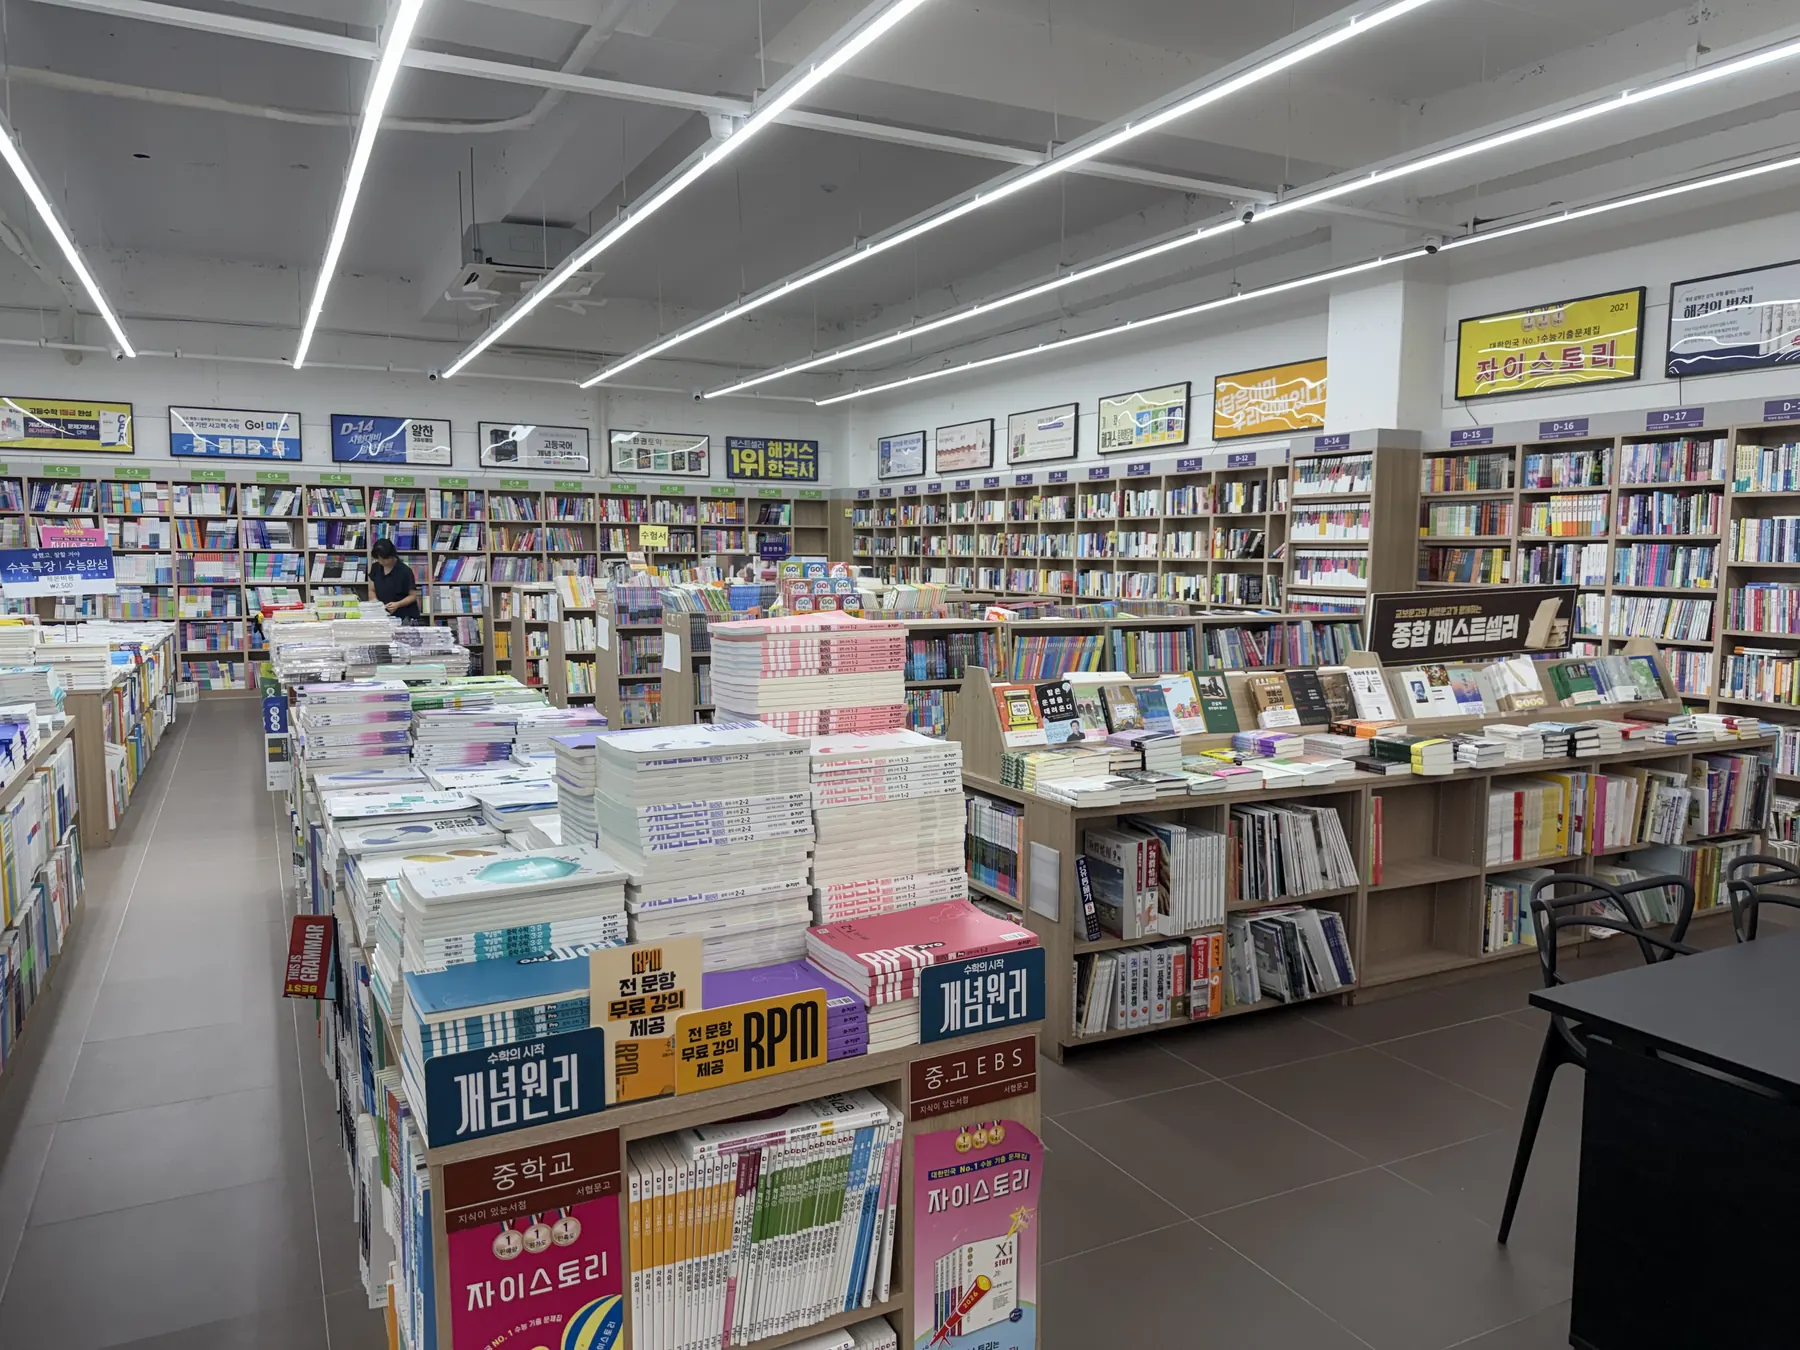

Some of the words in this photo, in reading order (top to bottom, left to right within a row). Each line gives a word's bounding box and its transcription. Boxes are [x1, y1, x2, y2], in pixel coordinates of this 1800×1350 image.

[1610, 303, 1628, 312] 2021
[1475, 339, 1616, 384] 자이스토리
[29, 408, 58, 416] 고등수학
[1663, 412, 1687, 421] D-17
[245, 420, 264, 430] Go!
[340, 420, 374, 435] D-14
[412, 424, 434, 437] 알찬
[1553, 422, 1574, 431] D-16
[1462, 430, 1481, 439] D-15
[544, 440, 572, 450] 고등국어
[730, 440, 764, 449] 베스트셀러
[768, 441, 814, 459] 해커스
[731, 449, 765, 477] 1위
[768, 459, 814, 478] 한국사
[641, 529, 666, 540] 수험서
[6, 560, 56, 574] 수능특강
[65, 559, 108, 571] 수능완성
[1392, 620, 1431, 649] 종합
[1434, 614, 1520, 646] 베스트셀러
[291, 954, 302, 963] IS
[300, 925, 324, 982] GRAMMAR
[632, 948, 662, 975] RPM
[288, 963, 300, 981] THIS
[964, 962, 987, 974] 수학의
[989, 959, 1004, 970] 시작
[286, 984, 317, 993] BEST
[619, 979, 636, 997] 전
[641, 971, 676, 993] 문항
[610, 999, 647, 1019] 무료
[650, 991, 684, 1011] 강의
[940, 968, 1026, 1033] 개념원리
[630, 1016, 664, 1037] 제공
[688, 1027, 702, 1042] 전
[705, 1022, 732, 1039] 문항
[744, 1000, 818, 1072] RPM
[487, 1047, 521, 1064] 수학의
[523, 1043, 545, 1057] 시작
[682, 1045, 709, 1062] 무료
[713, 1038, 738, 1056] 강의
[617, 1043, 639, 1077] RPM
[697, 1060, 724, 1078] 제공
[454, 1053, 578, 1136] 개념원리
[920, 1103, 940, 1114] 지식이
[492, 1152, 574, 1190] 중학교
[931, 1168, 956, 1178] 대한민국
[928, 1168, 1030, 1213] 자이스토리
[458, 1211, 486, 1224] 지식이
[534, 1229, 540, 1239] 1
[563, 1222, 568, 1232] 1
[506, 1236, 511, 1246] 1
[996, 1242, 1012, 1259] Xi
[995, 1257, 1012, 1267] story
[467, 1251, 607, 1311] 자이스토리
[963, 1291, 978, 1308] 2026
[492, 1335, 507, 1346] NO.
[514, 1323, 527, 1333] 수능
[529, 1318, 542, 1327] 기출
[543, 1315, 562, 1323] 문제집
